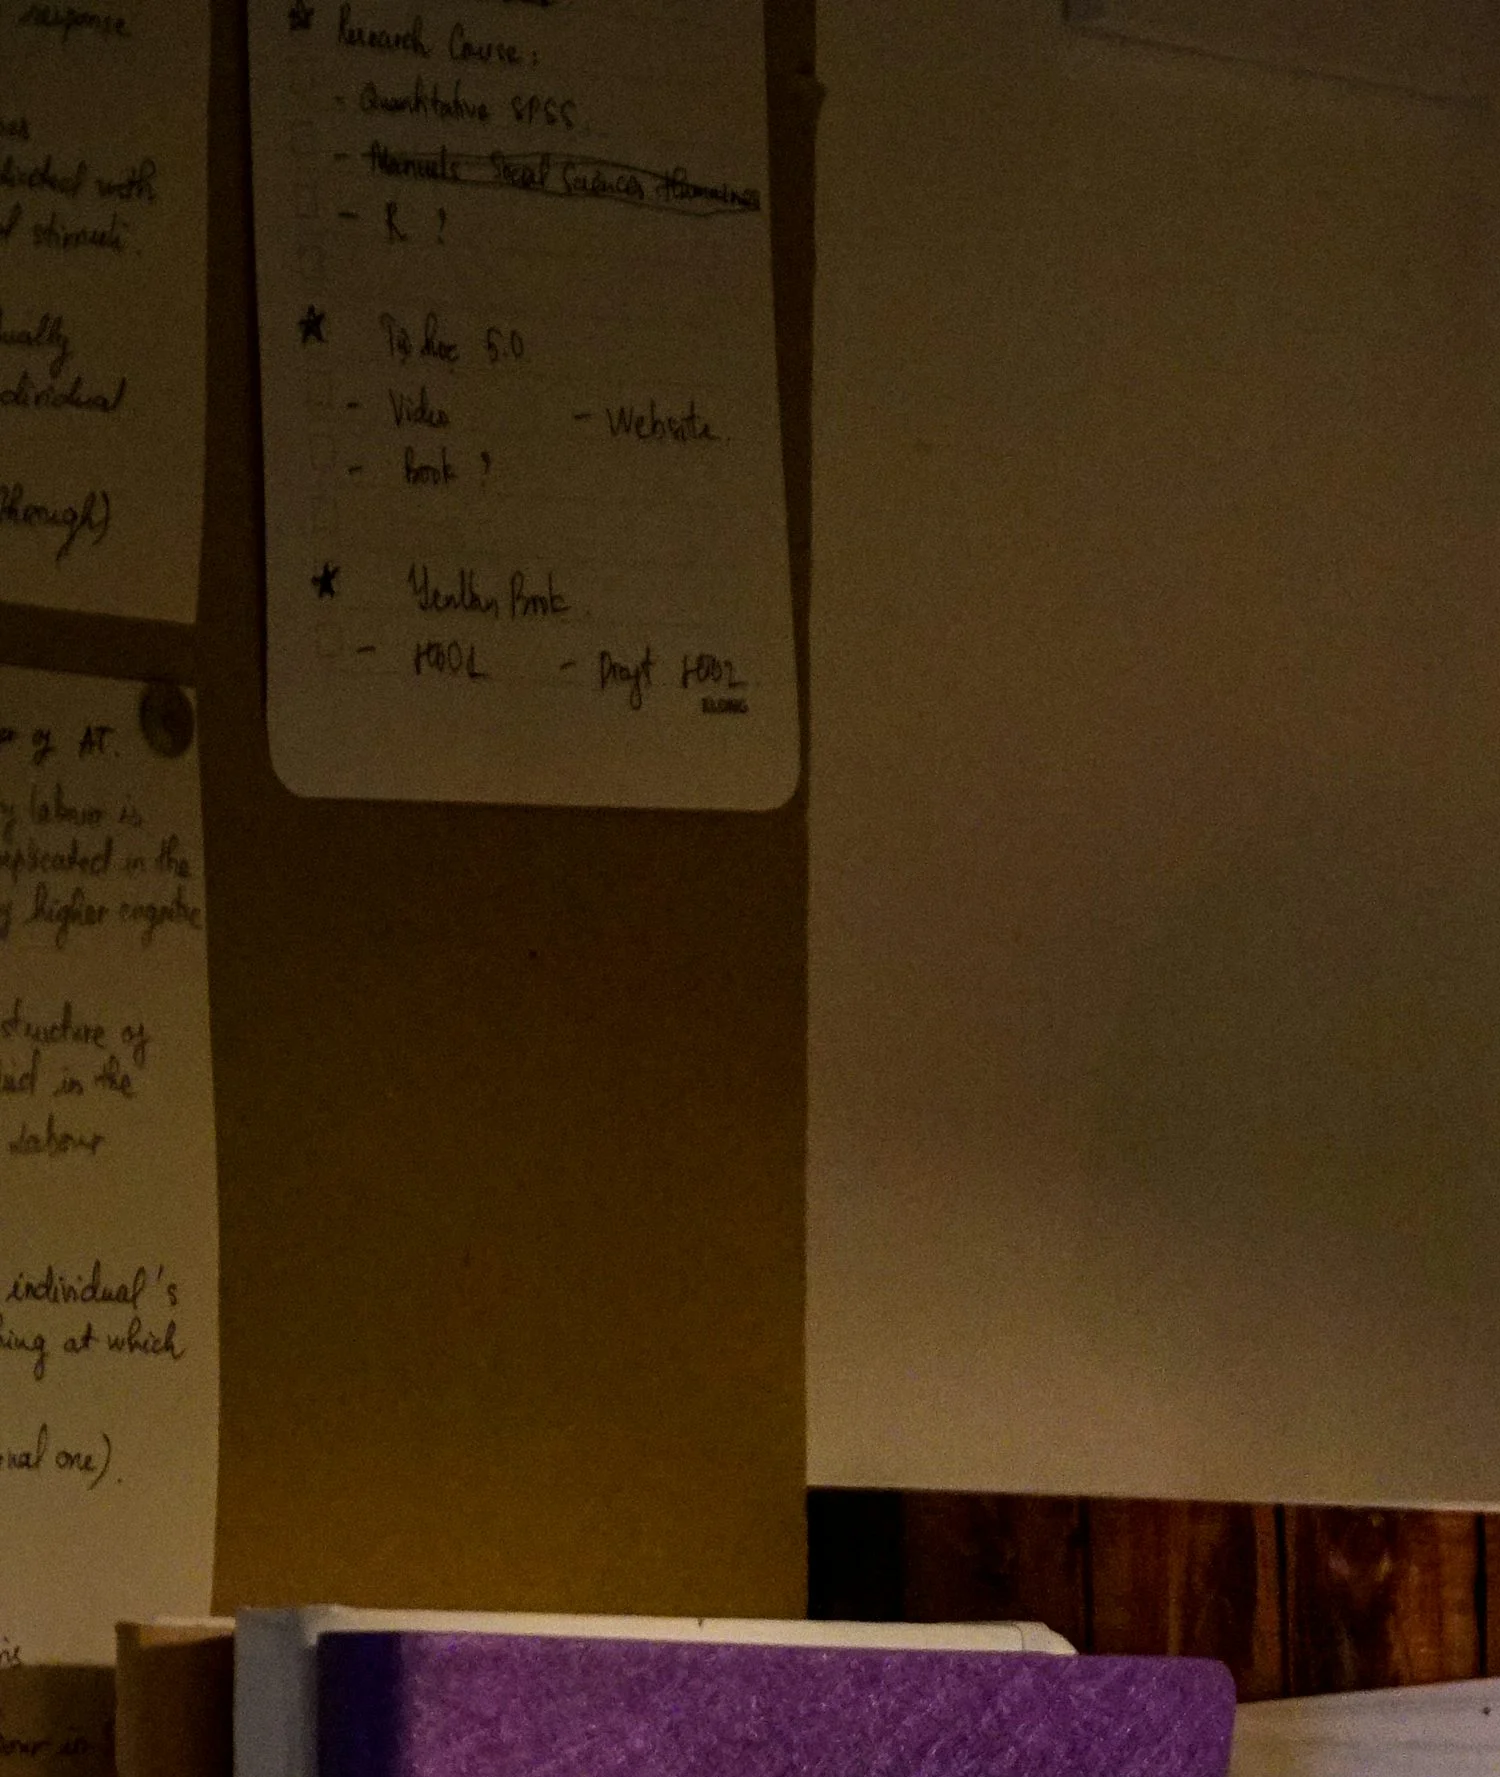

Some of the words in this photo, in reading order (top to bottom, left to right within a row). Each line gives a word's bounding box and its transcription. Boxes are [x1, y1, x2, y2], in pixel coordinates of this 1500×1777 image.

[10, 1259, 178, 1305] individual's
[63, 1322, 97, 1356] at
[106, 1317, 185, 1360] which
